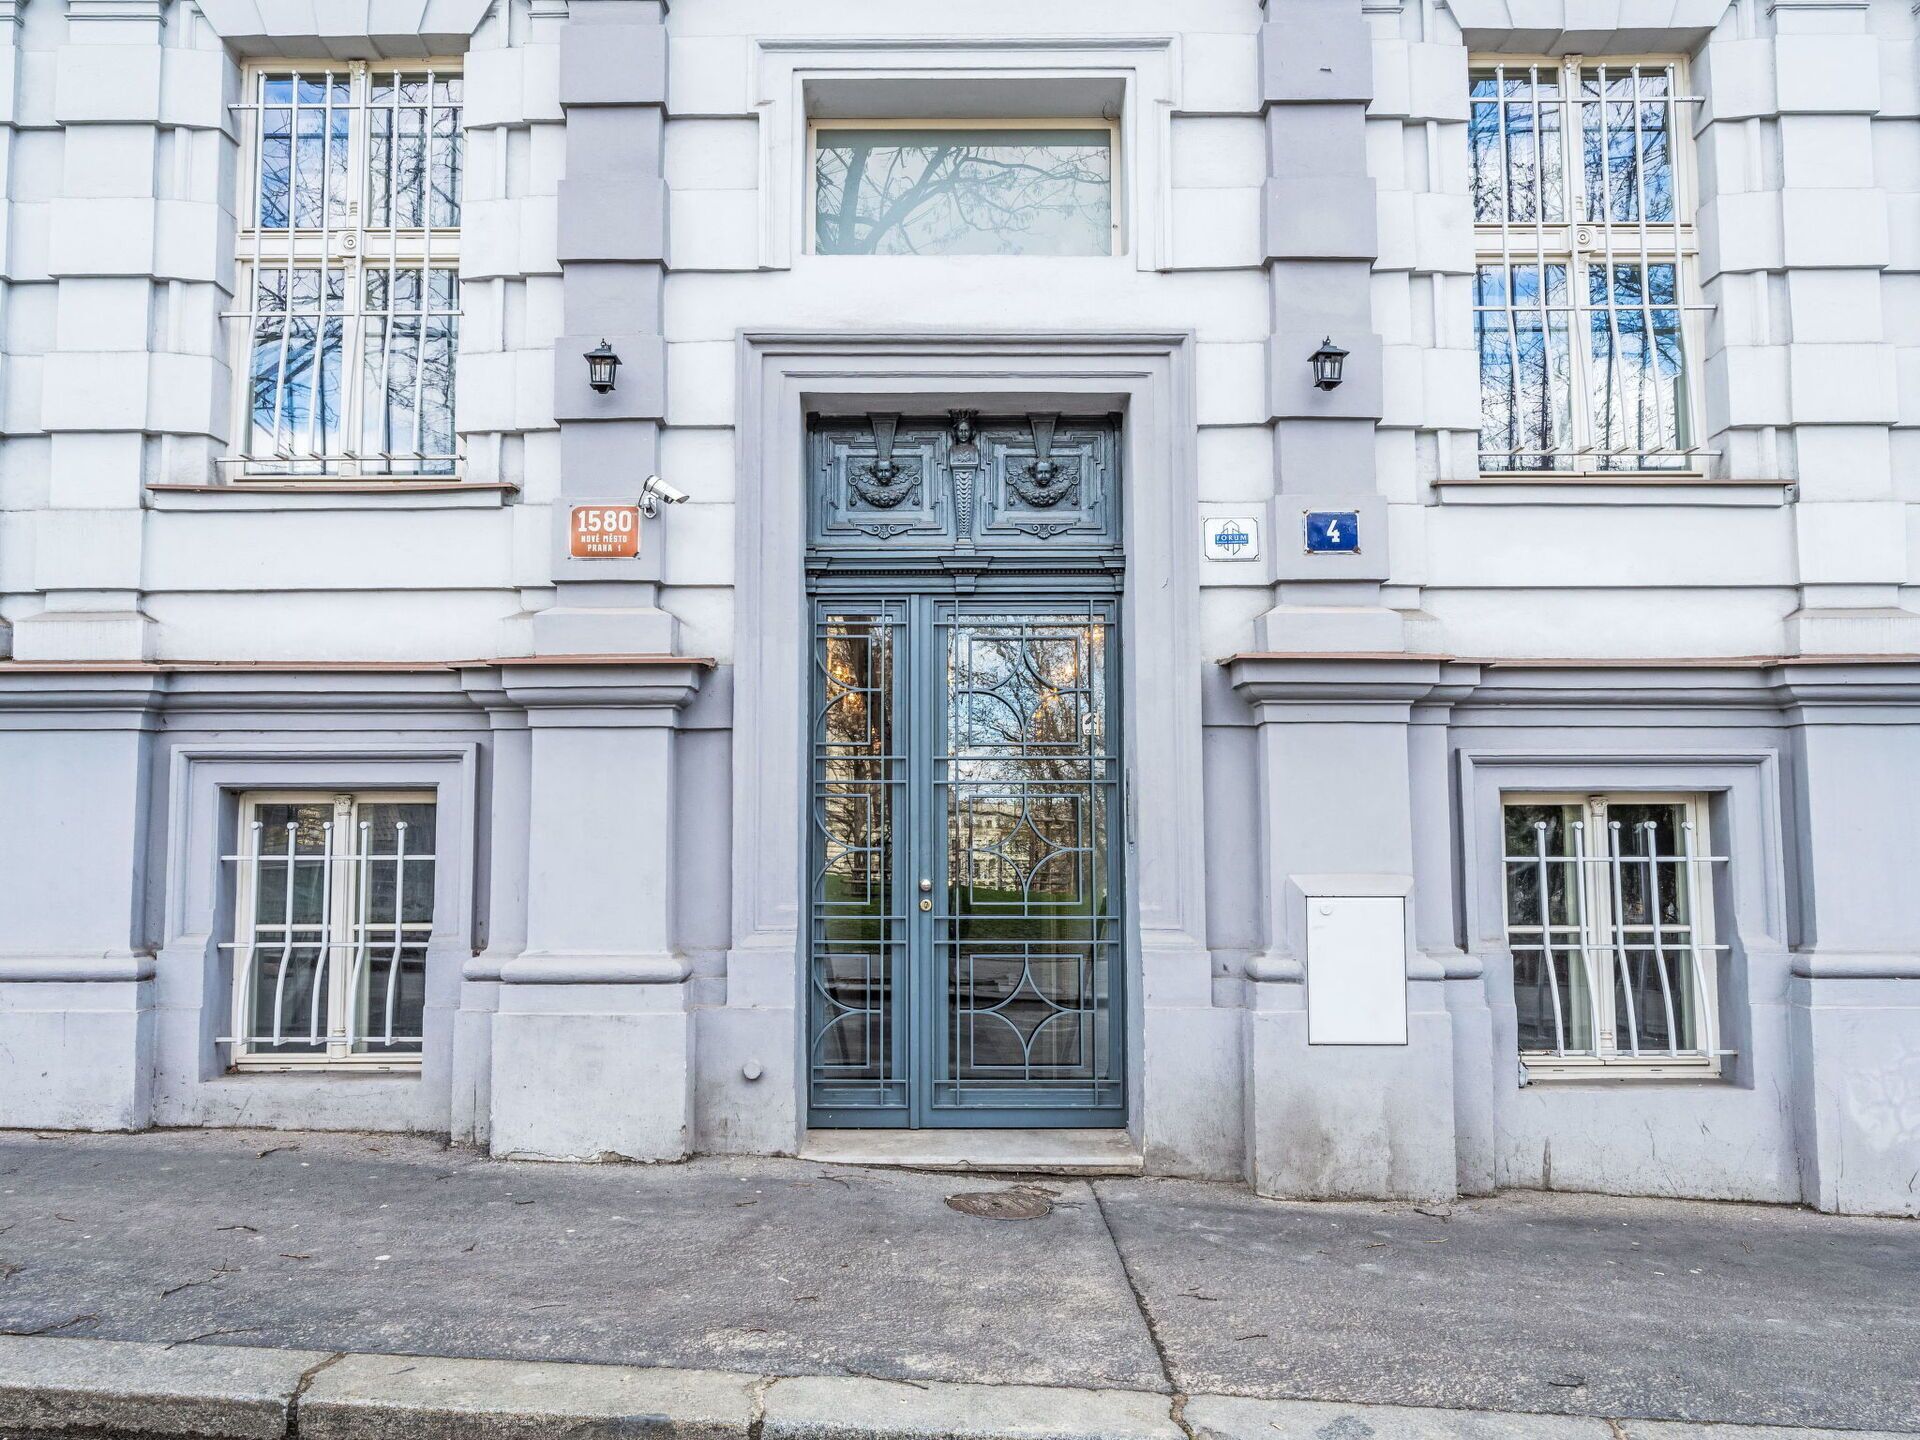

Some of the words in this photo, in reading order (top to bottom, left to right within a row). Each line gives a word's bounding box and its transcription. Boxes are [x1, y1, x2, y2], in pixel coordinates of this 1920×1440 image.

[577, 510, 632, 532] 1580
[580, 533, 600, 543] NOVÉ
[603, 533, 628, 543] MĚSTO
[1326, 519, 1340, 543] 4
[587, 544, 613, 552] PRAHA
[617, 544, 621, 552] 1
